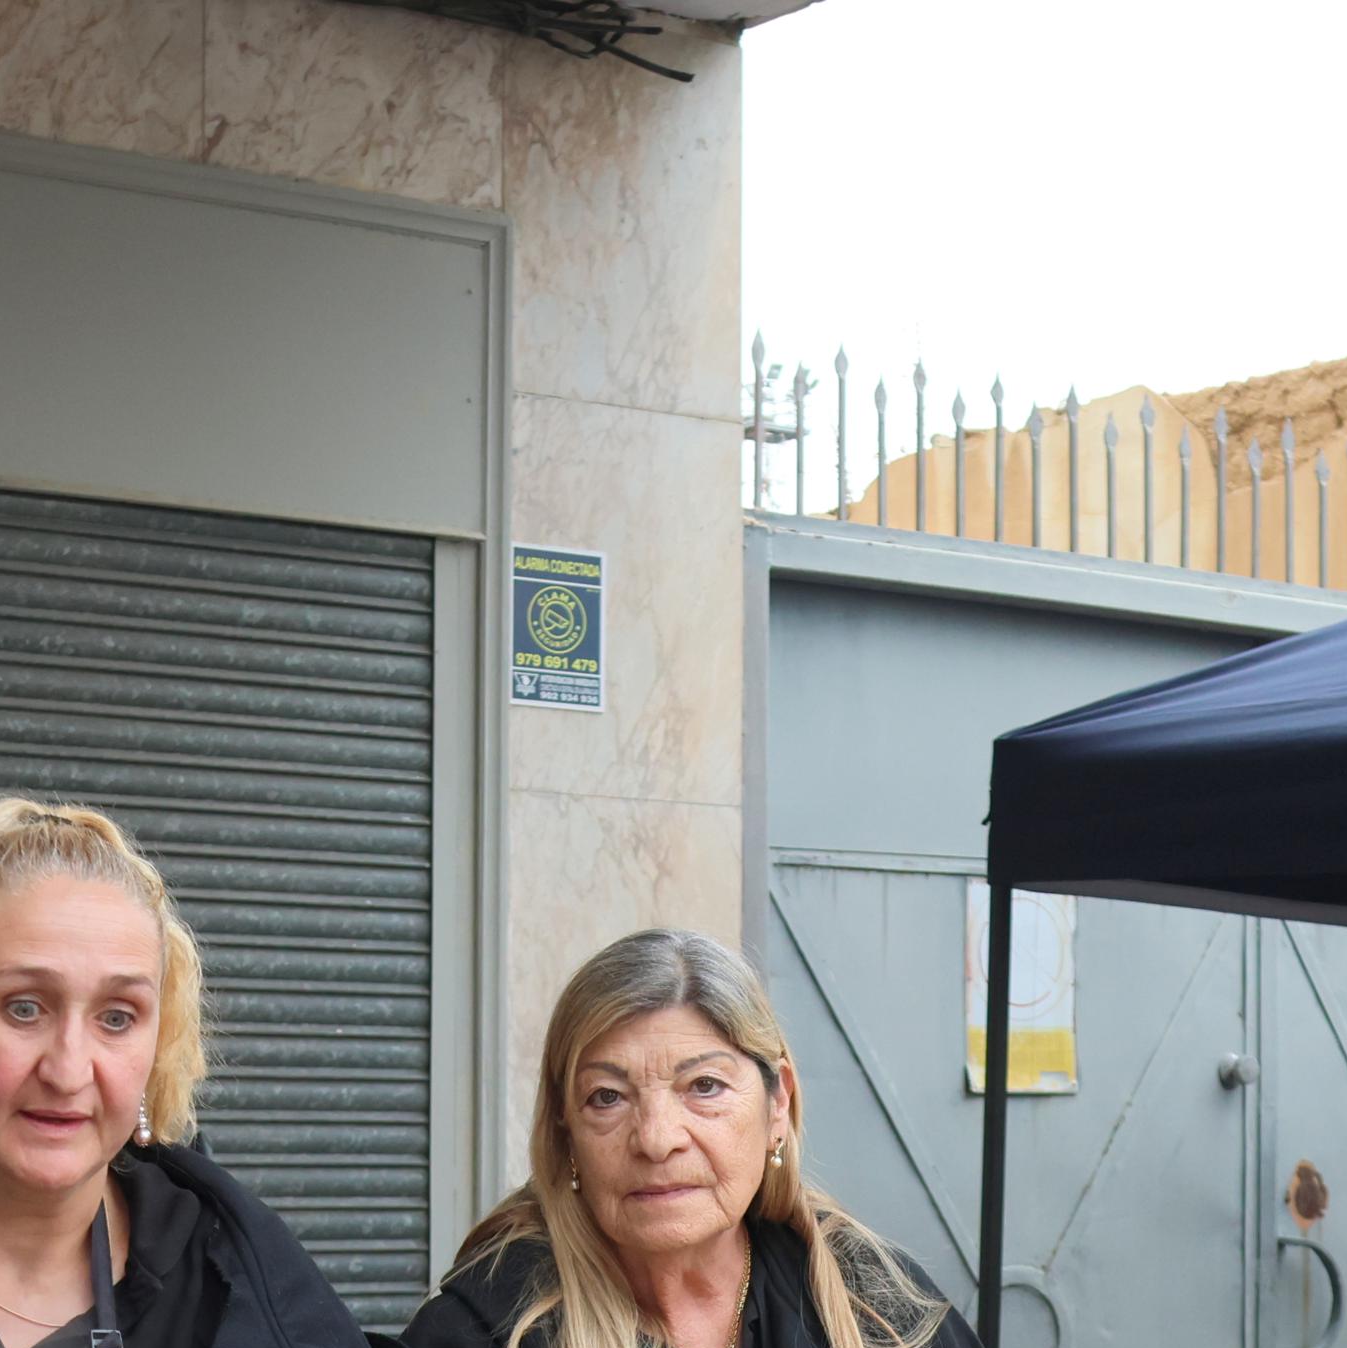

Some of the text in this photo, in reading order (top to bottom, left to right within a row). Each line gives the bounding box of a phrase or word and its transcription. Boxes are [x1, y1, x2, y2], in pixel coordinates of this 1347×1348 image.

[515, 652, 598, 672] 979 691 479
